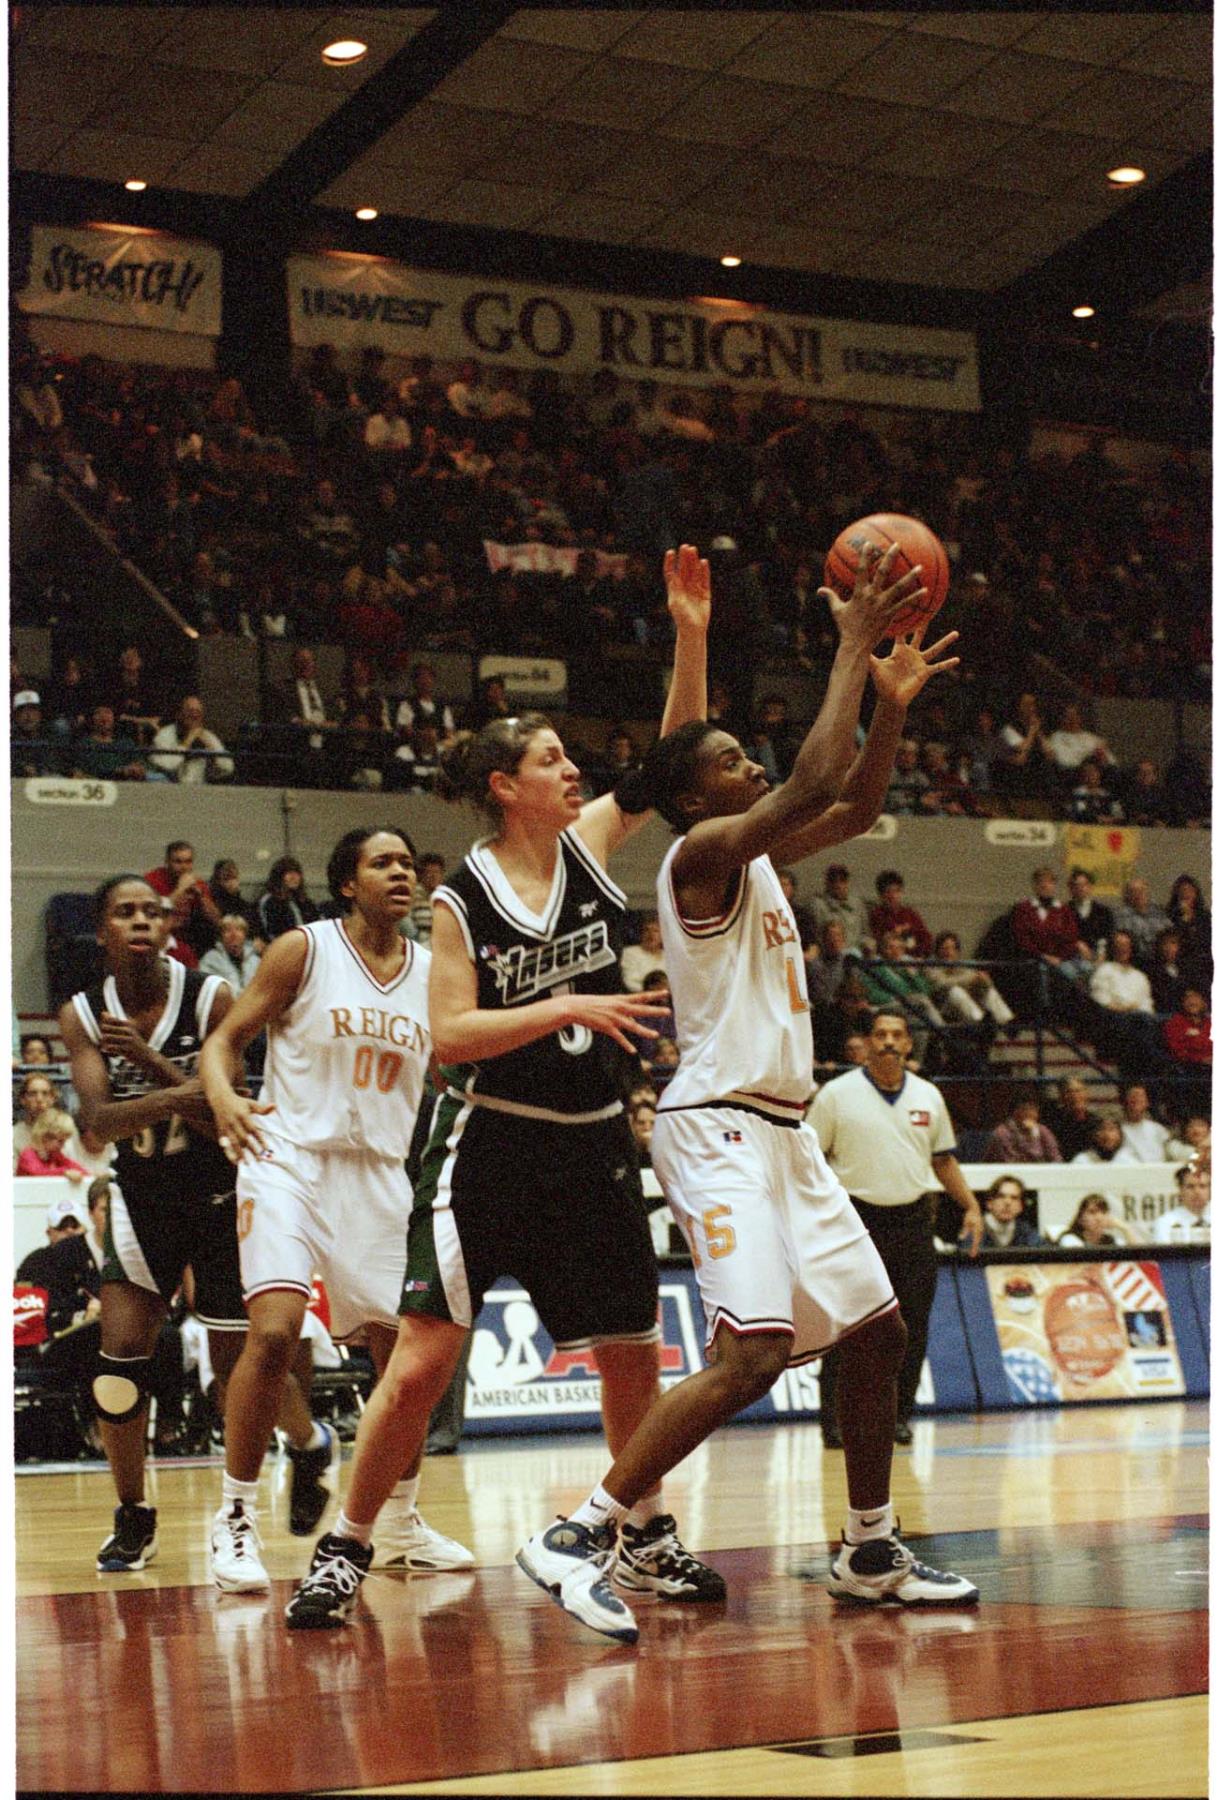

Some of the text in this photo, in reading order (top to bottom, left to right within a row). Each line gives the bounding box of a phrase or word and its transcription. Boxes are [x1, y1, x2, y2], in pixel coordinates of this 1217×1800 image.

[460, 292, 823, 384] GO REIGN!
[328, 1005, 430, 1055] REIGN
[352, 1044, 405, 1096] 00
[471, 1386, 551, 1408] AMERICAN
